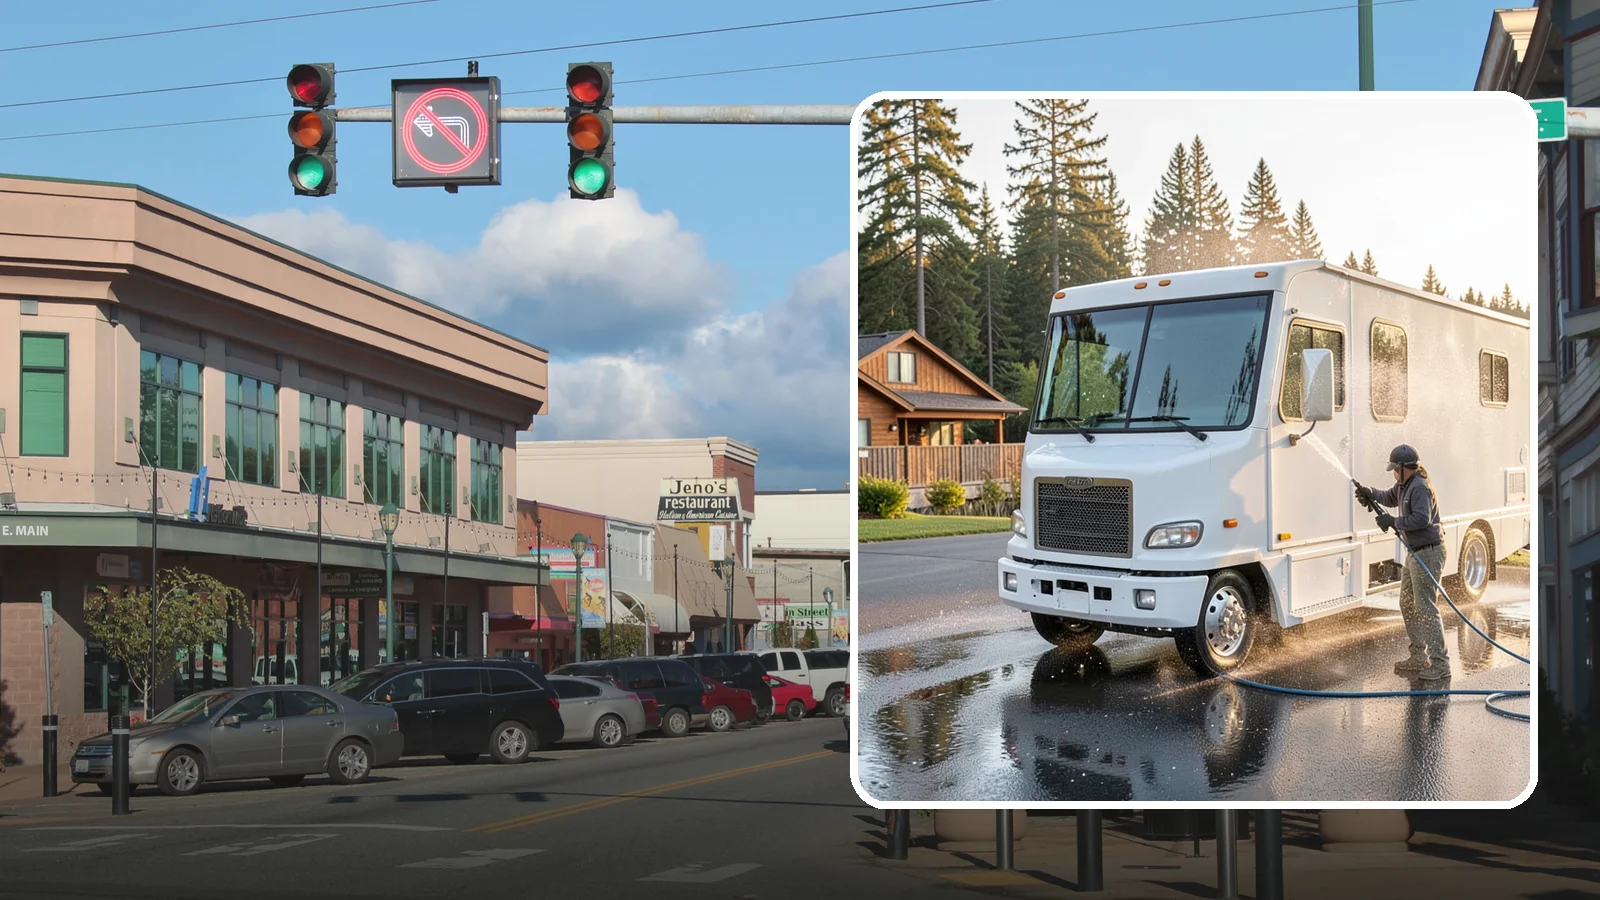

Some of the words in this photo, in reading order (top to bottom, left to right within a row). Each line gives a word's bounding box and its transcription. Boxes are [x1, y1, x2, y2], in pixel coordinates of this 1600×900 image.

[670, 479, 727, 494] Jeno's
[665, 497, 731, 509] restaurant
[658, 509, 681, 519] Italian
[686, 509, 715, 519] American
[715, 509, 738, 519] Cuisine
[2, 525, 13, 536] E.
[15, 525, 49, 536] MAIN
[797, 607, 828, 617] Street
